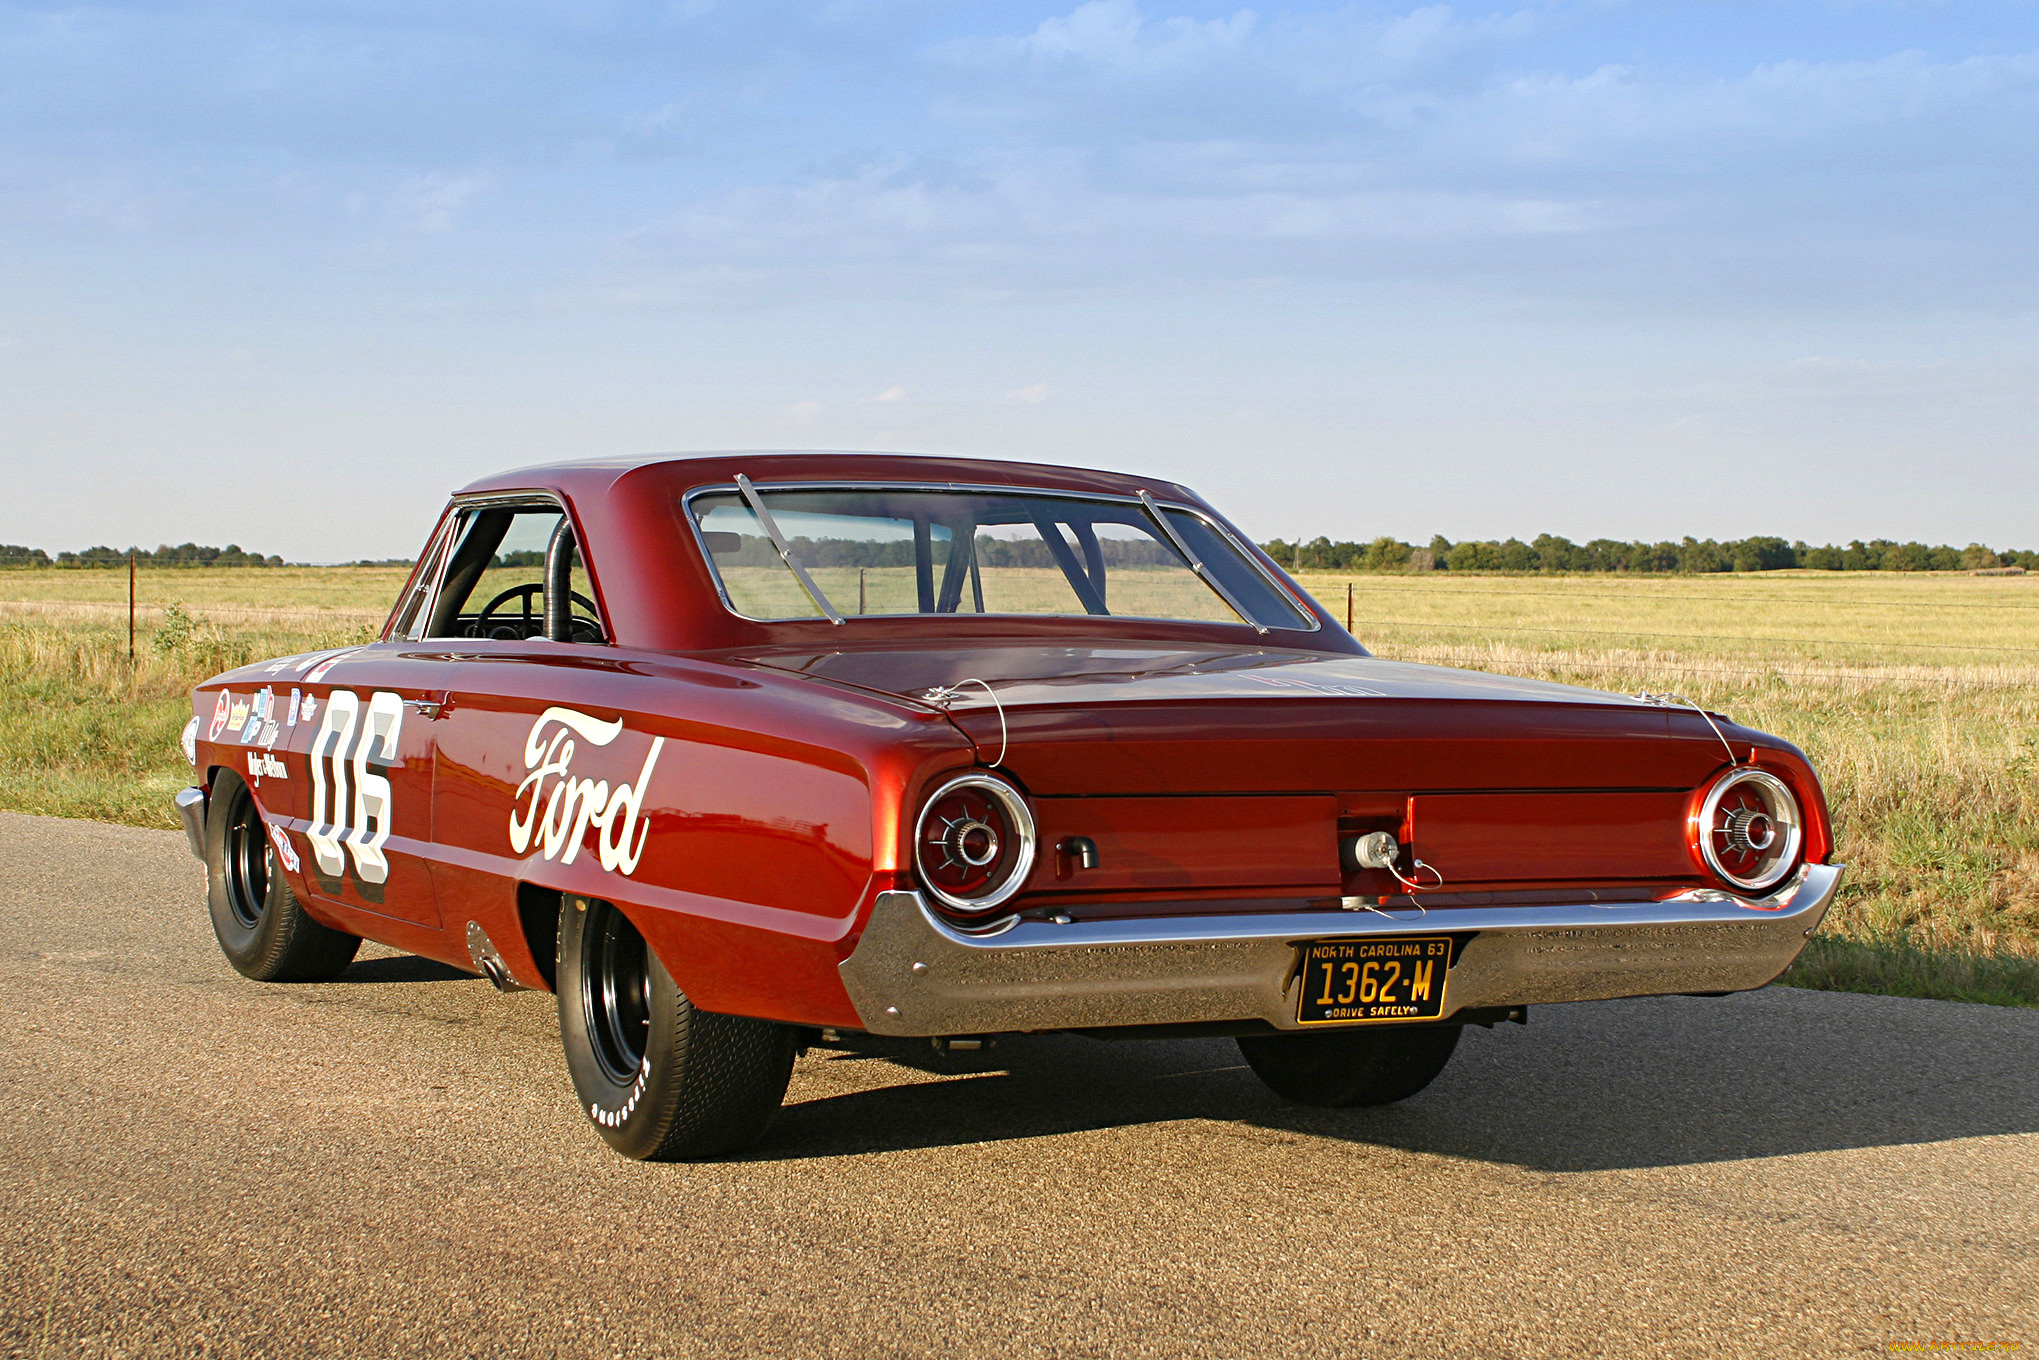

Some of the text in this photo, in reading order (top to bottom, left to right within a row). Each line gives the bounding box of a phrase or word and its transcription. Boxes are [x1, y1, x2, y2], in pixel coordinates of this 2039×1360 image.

[306, 689, 404, 884] 06
[509, 706, 666, 876] Ford
[1312, 943, 1445, 959] NORTH CAROLINA 63
[1333, 1005, 1410, 1018] DRIVE SAFELY
